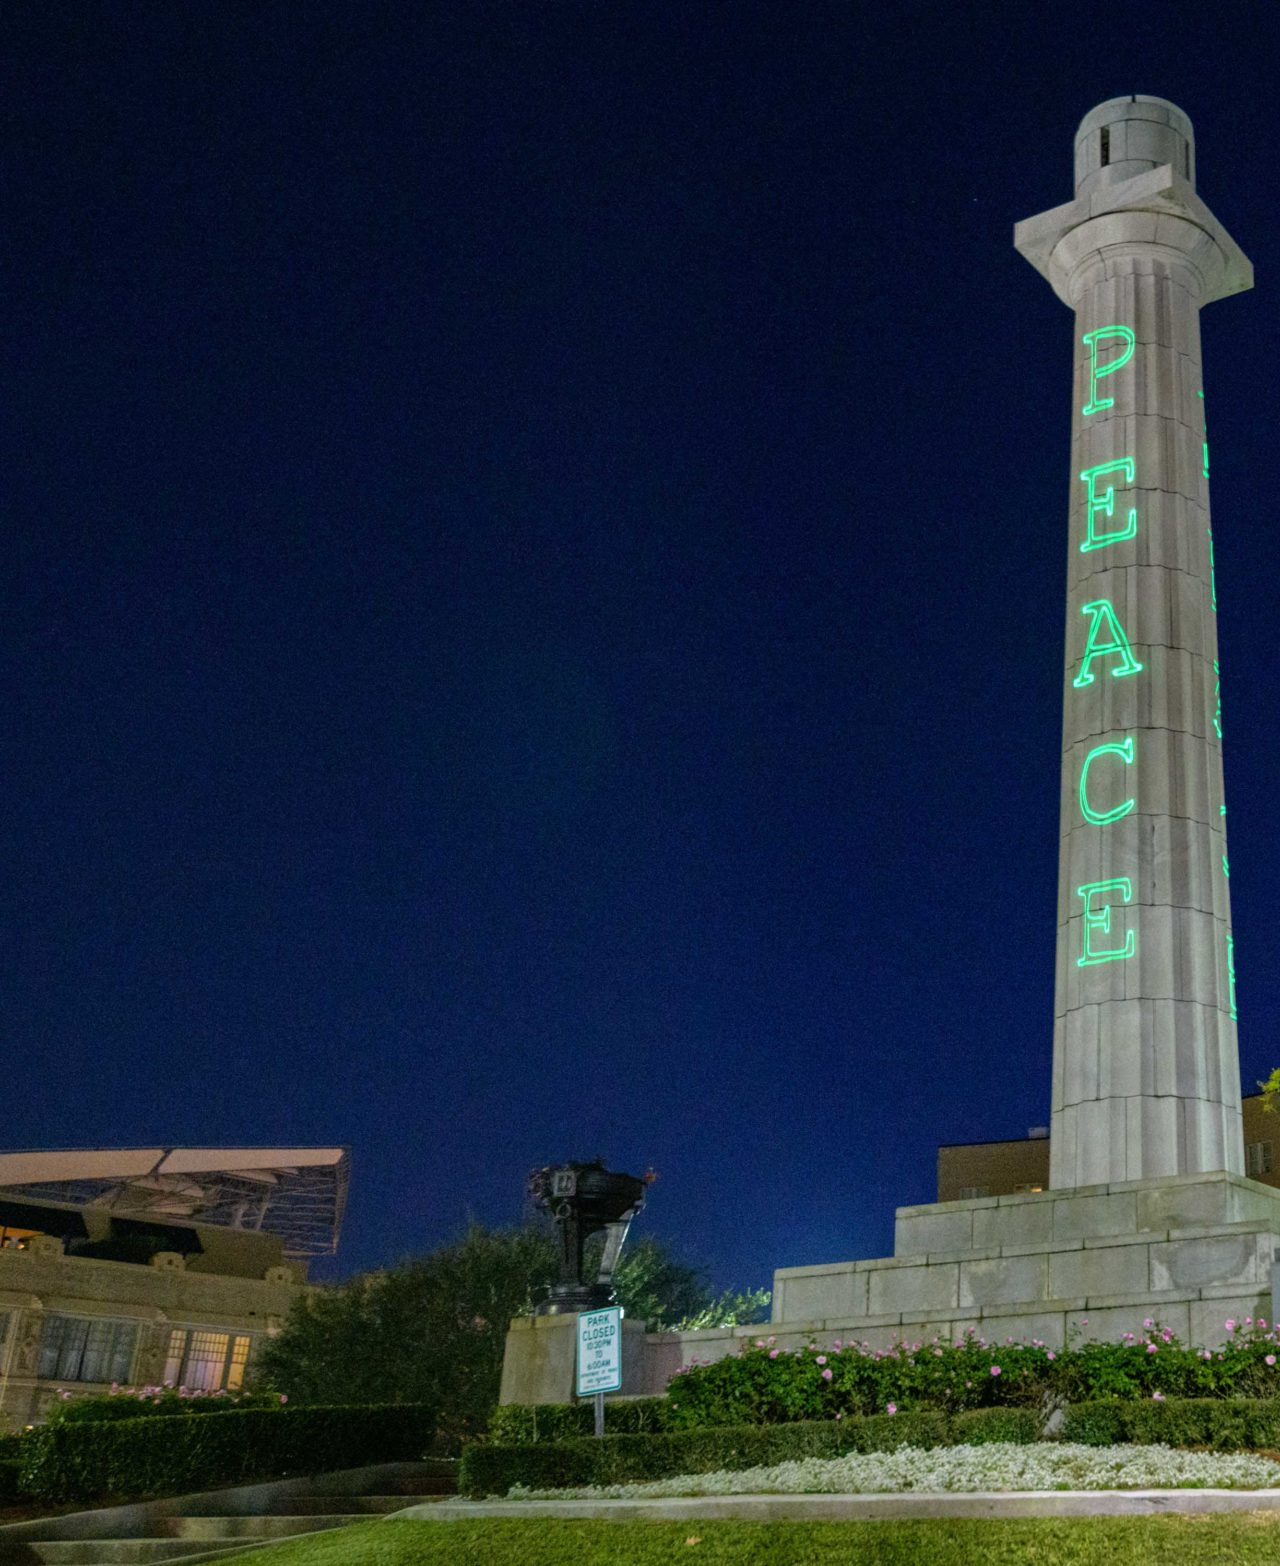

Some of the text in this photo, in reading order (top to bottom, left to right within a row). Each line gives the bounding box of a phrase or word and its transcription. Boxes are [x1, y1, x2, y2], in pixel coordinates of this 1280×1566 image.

[1073, 324, 1144, 968] PEACE
[587, 1314, 609, 1327] PARK
[583, 1325, 615, 1341] CLOSED
[595, 1350, 603, 1358] TO
